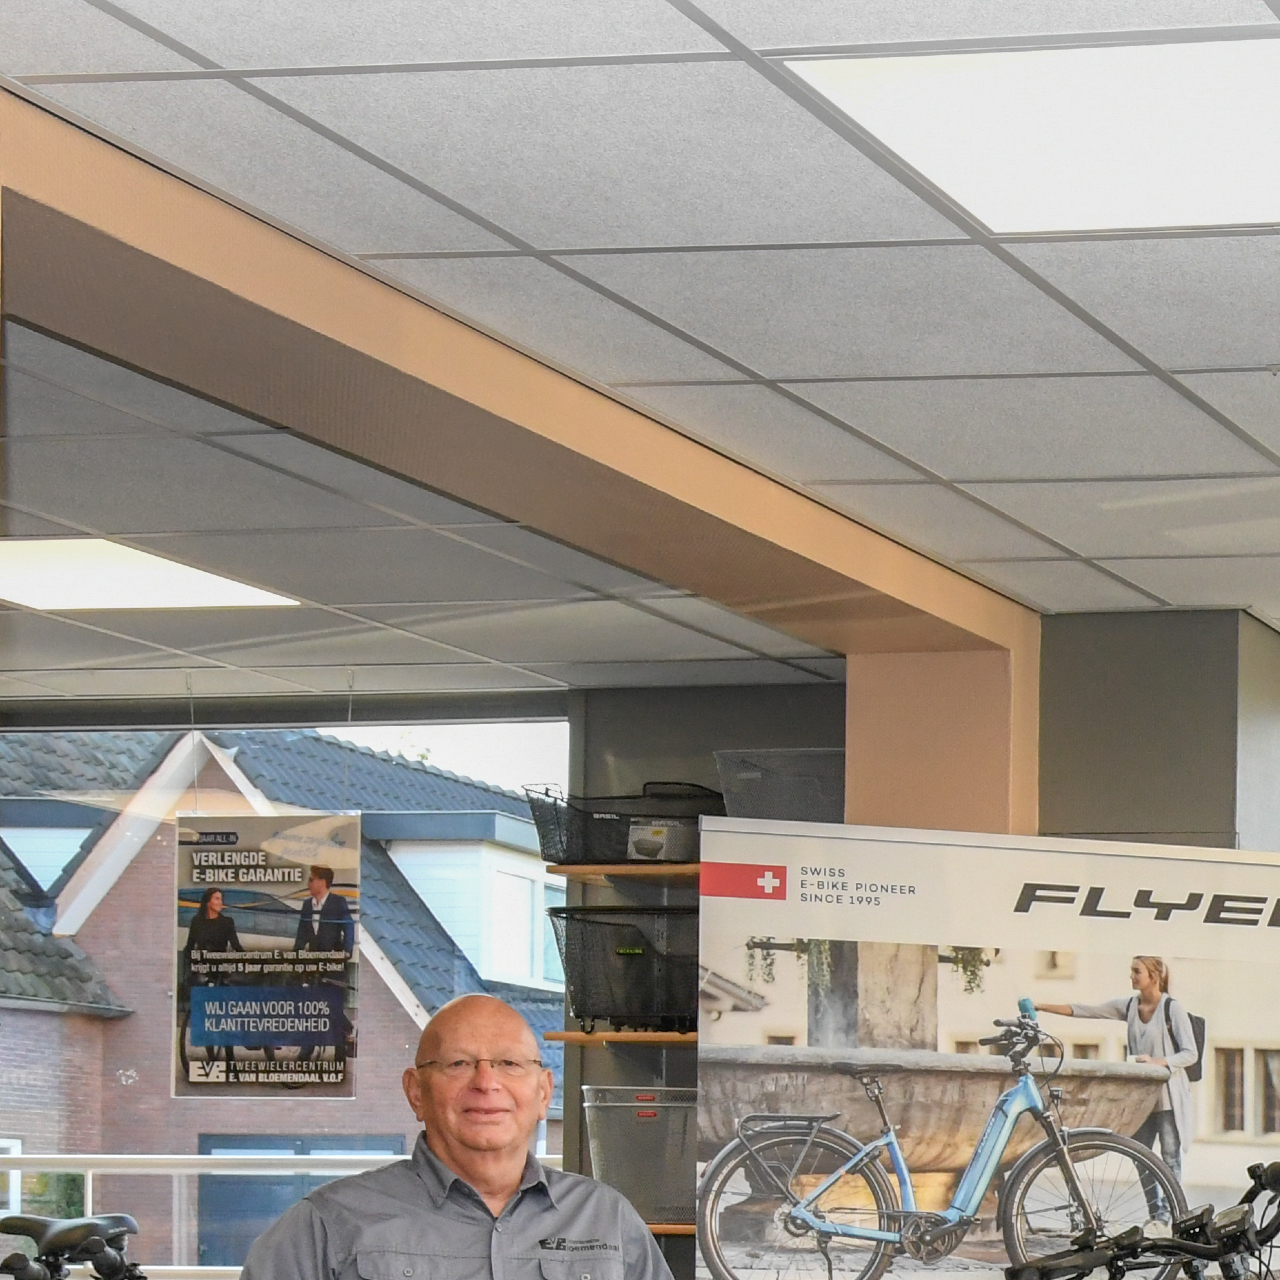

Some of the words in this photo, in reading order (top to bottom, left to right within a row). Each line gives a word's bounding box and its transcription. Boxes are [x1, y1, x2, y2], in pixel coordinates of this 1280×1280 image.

[192, 852, 266, 866] VERLENGDE
[192, 868, 235, 882] E-BIKE
[239, 868, 302, 882] GARANTIE
[800, 866, 845, 878] SWISS
[800, 880, 848, 891] E-BIKE
[856, 882, 916, 895] PIONEER
[800, 893, 843, 904] SINCE
[849, 896, 881, 906] 1995
[245, 963, 261, 973] jaar
[263, 963, 293, 973] garantie
[204, 1001, 226, 1015] WIJ
[228, 1001, 261, 1015] GAAN
[263, 1001, 295, 1015] VOOR
[298, 1001, 330, 1015] 100%
[204, 1018, 330, 1032] KLANTTEVREDENHEID
[230, 1061, 344, 1071] TWEEWIELERCENTRUM
[238, 1073, 256, 1082] VAN
[258, 1073, 320, 1082] BLOEMENDAAL
